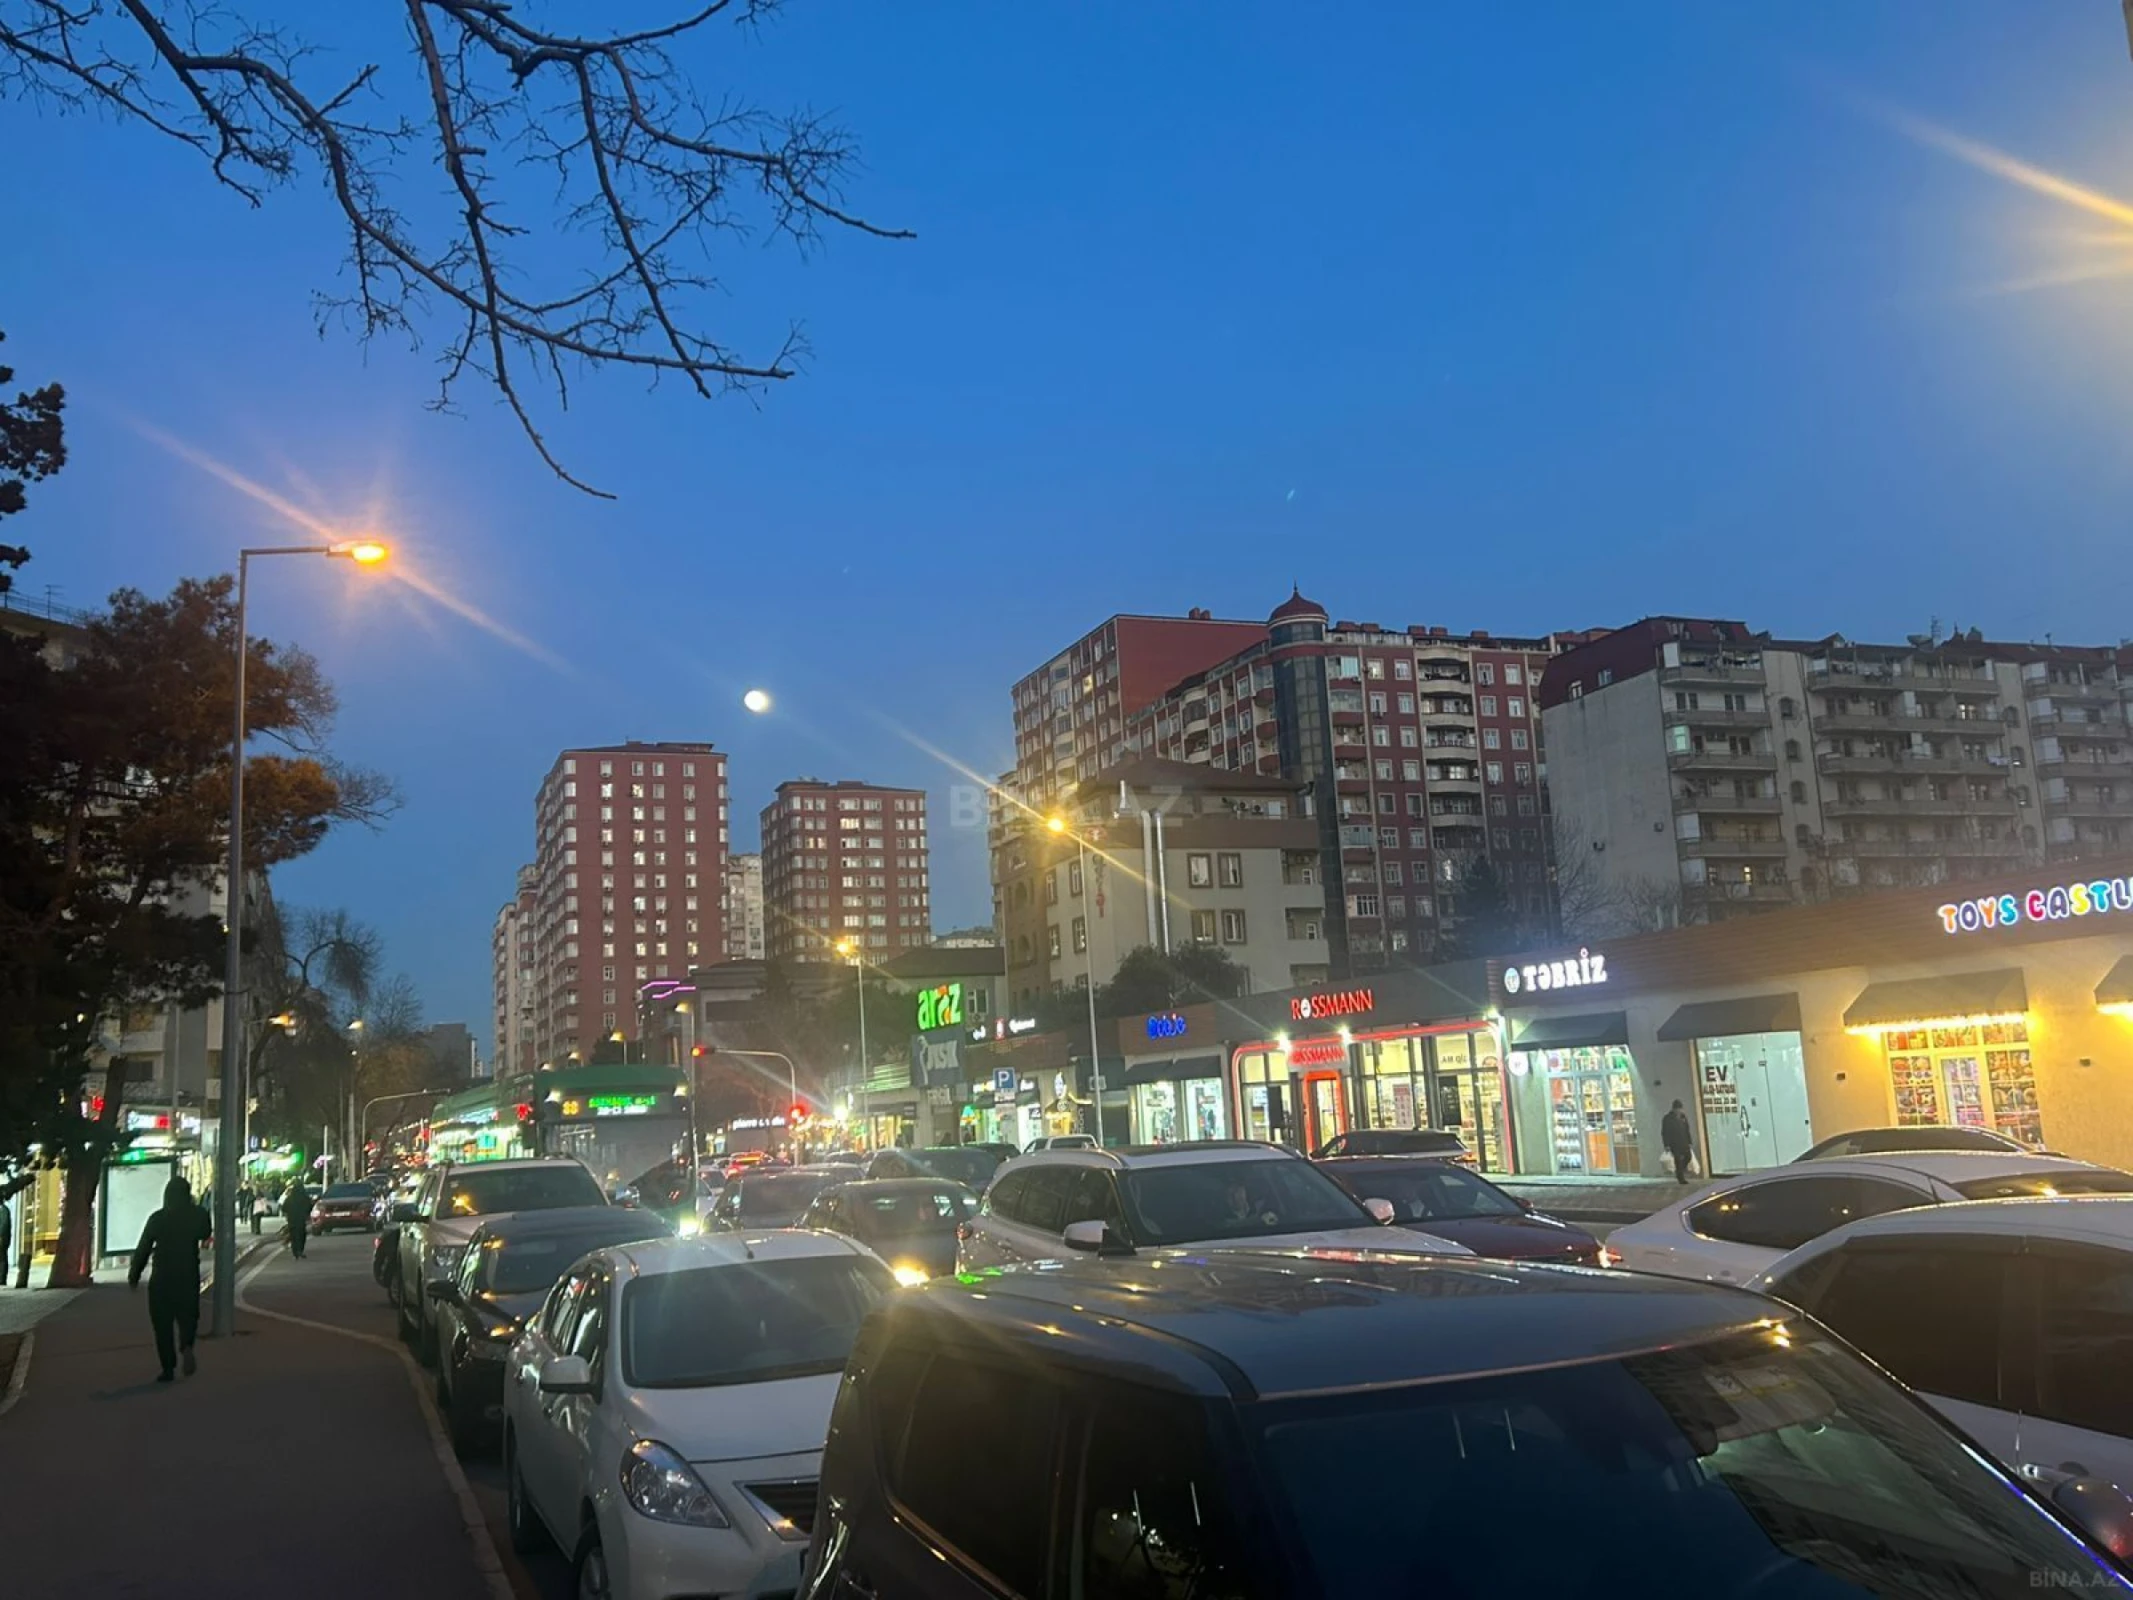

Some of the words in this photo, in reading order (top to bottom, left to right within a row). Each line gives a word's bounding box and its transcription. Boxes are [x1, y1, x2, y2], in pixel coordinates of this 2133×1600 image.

[1938, 894, 2018, 933] TOYS
[2026, 878, 2133, 921] CASTL
[1523, 947, 1607, 992] TƏBRİZ
[918, 983, 961, 1030] araz
[1291, 988, 1373, 1020] ROSSMANN
[997, 1070, 1011, 1088] P
[1705, 1064, 1728, 1082] EV
